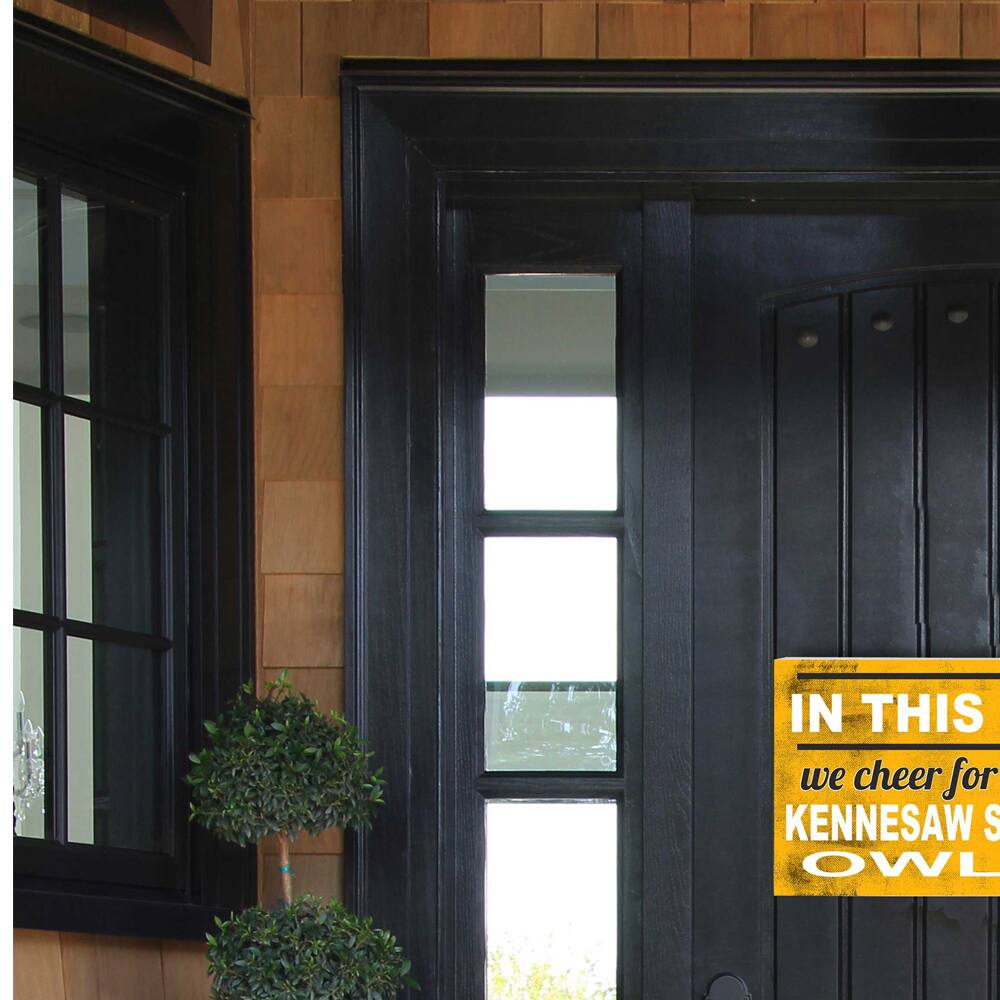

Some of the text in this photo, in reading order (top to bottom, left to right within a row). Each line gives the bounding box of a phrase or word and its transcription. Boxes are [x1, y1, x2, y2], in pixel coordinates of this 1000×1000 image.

[791, 693, 843, 733] IN
[861, 693, 984, 733] THIS
[800, 766, 846, 791] we
[854, 758, 943, 791] cheer
[942, 756, 999, 801] for
[785, 804, 974, 841] KENNESAW
